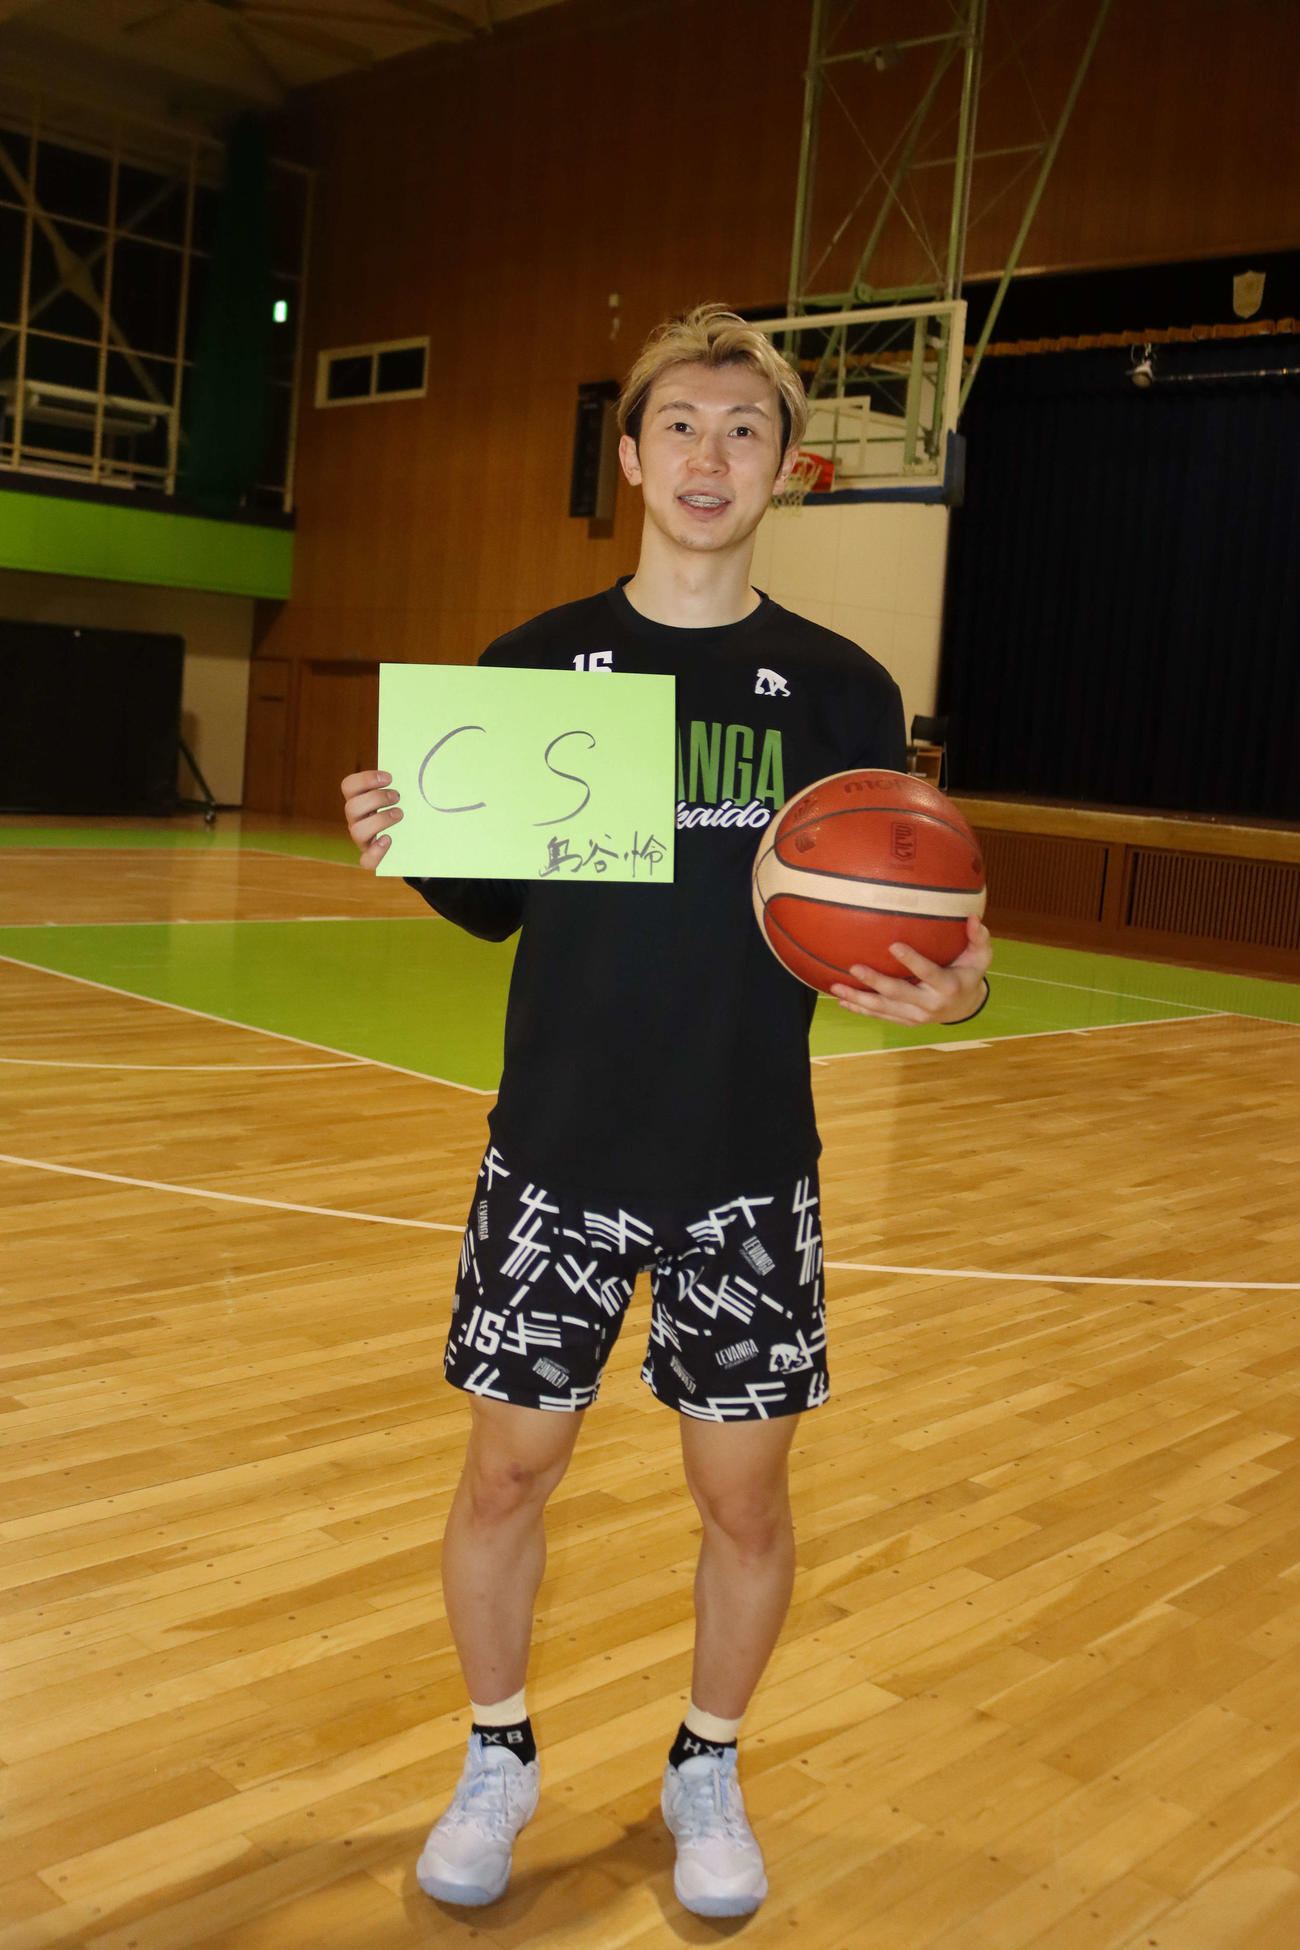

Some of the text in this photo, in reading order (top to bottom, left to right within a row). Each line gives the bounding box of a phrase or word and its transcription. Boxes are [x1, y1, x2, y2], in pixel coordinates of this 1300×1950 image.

[742, 1235, 776, 1277] LEVANGA
[464, 1305, 506, 1356] 15
[714, 1338, 760, 1367] LEVANGA
[532, 1357, 570, 1389] LEVANGA
